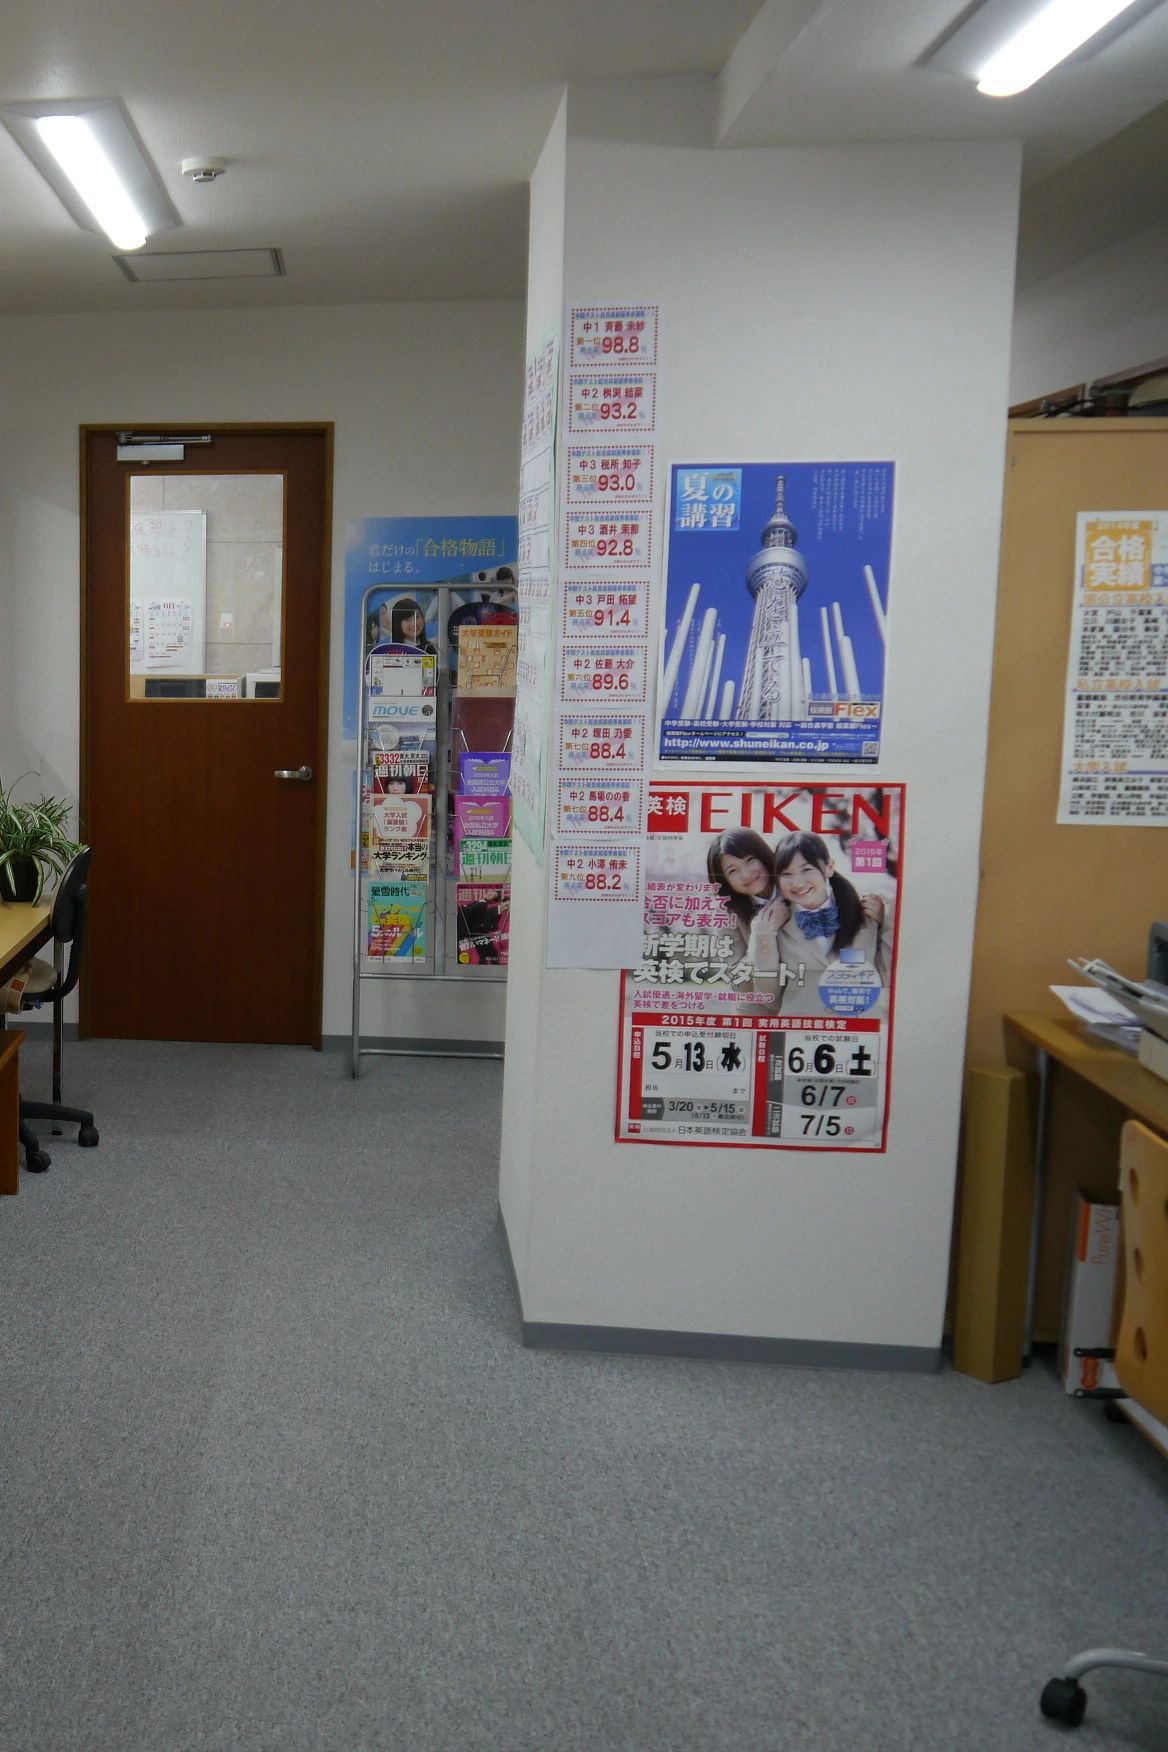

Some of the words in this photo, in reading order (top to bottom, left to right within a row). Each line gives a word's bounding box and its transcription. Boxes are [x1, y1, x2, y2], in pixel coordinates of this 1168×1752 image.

[584, 321, 598, 333] 中1
[602, 336, 639, 354] 98.8
[582, 387, 598, 398] 中2
[600, 403, 637, 419] 93.2
[580, 460, 596, 471] 中3
[623, 459, 641, 470] 知子
[598, 474, 635, 491] 93.0
[680, 472, 735, 502] 夏の
[678, 502, 736, 528] 講習
[578, 524, 595, 535] 中3
[600, 524, 617, 535] 酒井
[597, 539, 633, 556] 92.8
[1090, 534, 1146, 561] 合格
[576, 594, 592, 605] 中3
[597, 594, 614, 605] 戸田
[594, 609, 630, 626] 91.4
[574, 659, 590, 669] 中2
[617, 659, 634, 669] 大介
[592, 673, 629, 690] 89.6
[834, 703, 878, 716] Flex
[572, 728, 588, 739] 中2
[591, 742, 626, 759] 88.4
[664, 738, 829, 751] http://www.shuneikan.co.jp
[380, 754, 400, 764] 3332
[375, 764, 428, 777] 週刊朝日
[570, 791, 584, 801] 中2
[588, 806, 624, 822] 88.4
[648, 796, 687, 815] 英検
[700, 793, 891, 836] EIKEN
[408, 843, 428, 852] 本当の
[466, 841, 488, 852] 3294
[374, 852, 427, 861] 大学ランキング
[567, 859, 583, 870] 中2
[586, 874, 622, 890] 88.2
[645, 882, 721, 893] 績表が変わります
[634, 960, 806, 987] 英検でスタート!
[633, 1001, 705, 1010] 英検で差をつける
[662, 1015, 716, 1025] 2015年度
[722, 1017, 753, 1027] 第1回
[759, 1019, 847, 1029] 実用英語技能検定
[655, 1030, 736, 1039] 当校での申込受付締切日
[801, 1085, 846, 1106] 6/7
[669, 1101, 693, 1111] 3/20
[710, 1103, 735, 1113] 5/15
[678, 1126, 747, 1136] 日本英語検定協会
[801, 1115, 841, 1136] 7/5
